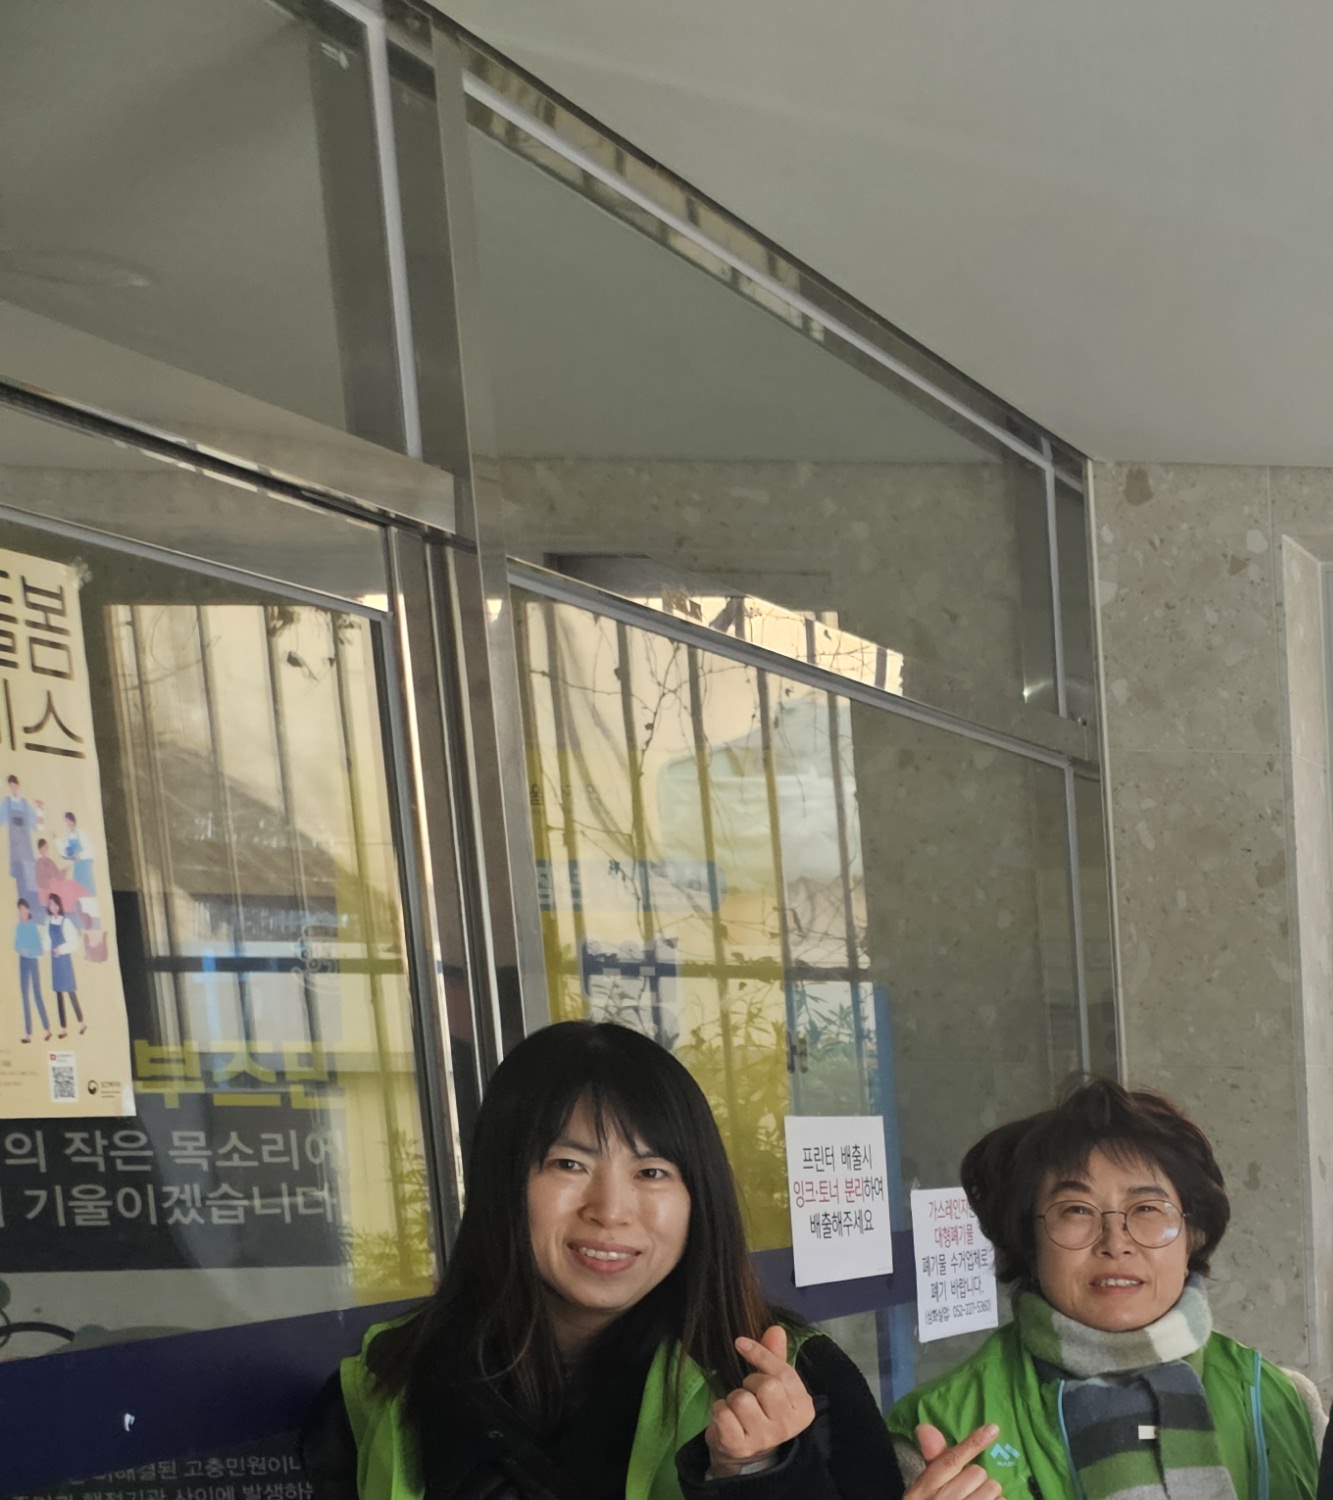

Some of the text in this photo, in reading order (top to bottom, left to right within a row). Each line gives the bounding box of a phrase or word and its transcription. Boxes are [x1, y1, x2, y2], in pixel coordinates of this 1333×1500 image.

[0, 677, 87, 760] 스
[64, 1129, 154, 1173] 작은
[802, 1143, 873, 1173] 프린터 배출시
[23, 1182, 335, 1228] 기울이겠습니다
[844, 1176, 885, 1204] 분리하여
[809, 1209, 875, 1240] 배출해주세요
[933, 1223, 975, 1249] 대형폐기물
[921, 1253, 948, 1277] 폐기물
[930, 1281, 948, 1303] 폐기
